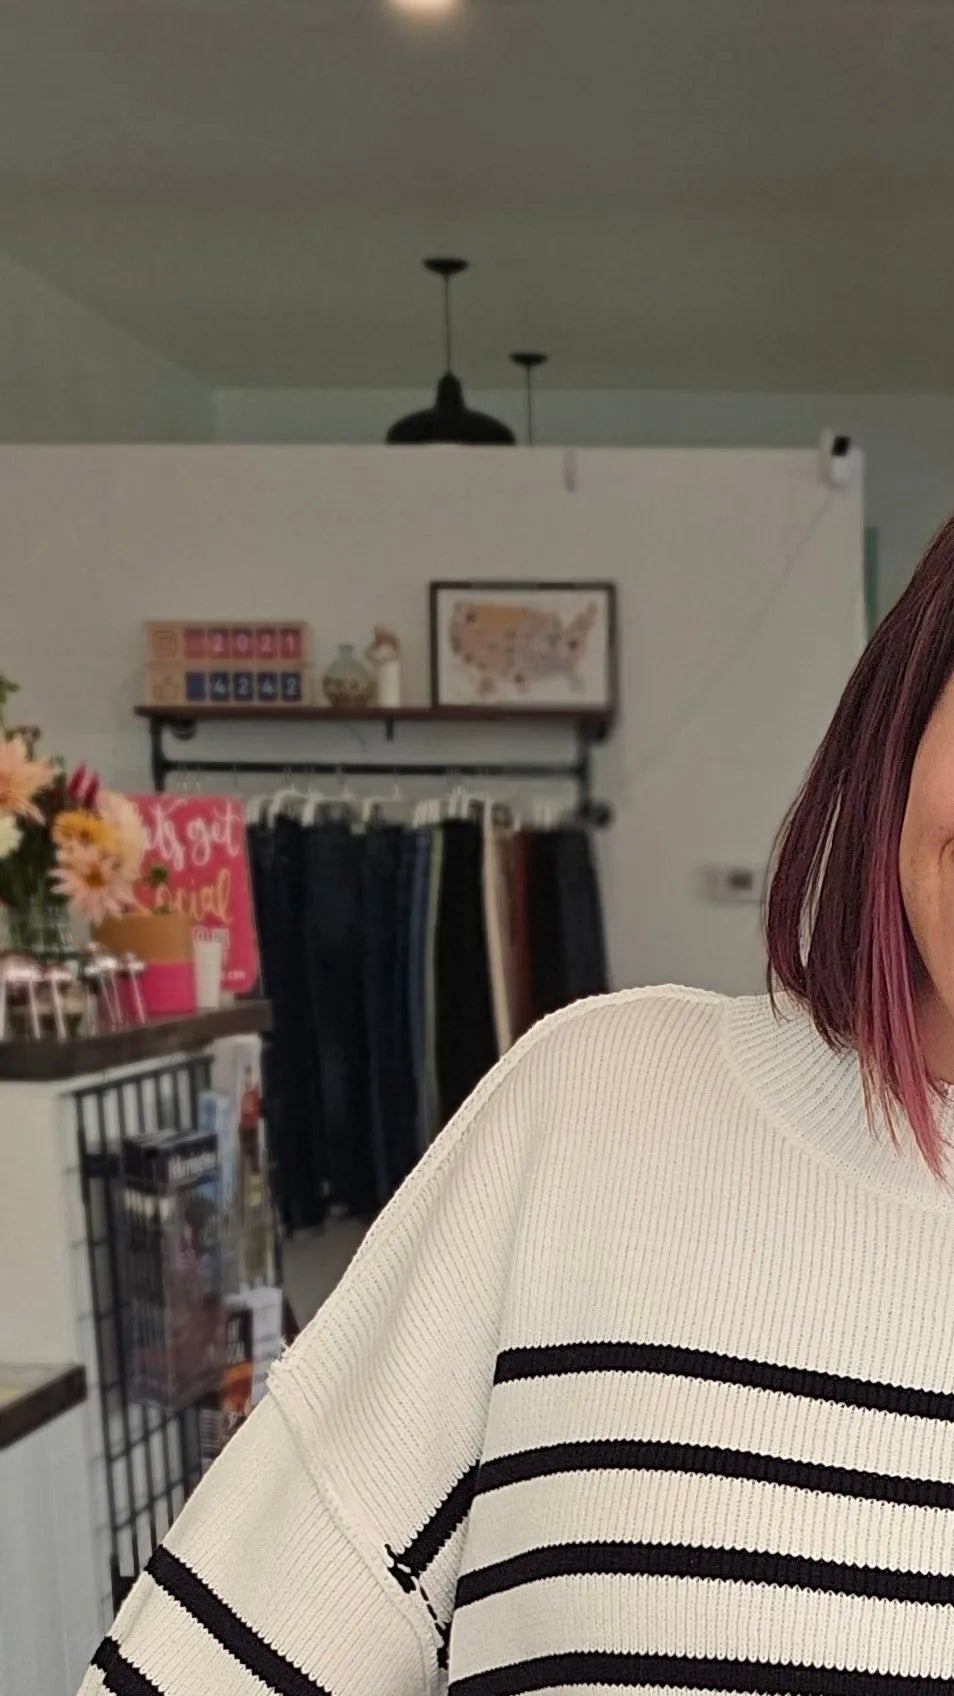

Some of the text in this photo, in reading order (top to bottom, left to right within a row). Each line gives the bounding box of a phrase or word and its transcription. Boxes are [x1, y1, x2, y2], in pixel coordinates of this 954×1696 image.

[212, 632, 296, 654] 2021
[213, 676, 298, 697] 4242
[187, 801, 240, 866] get
